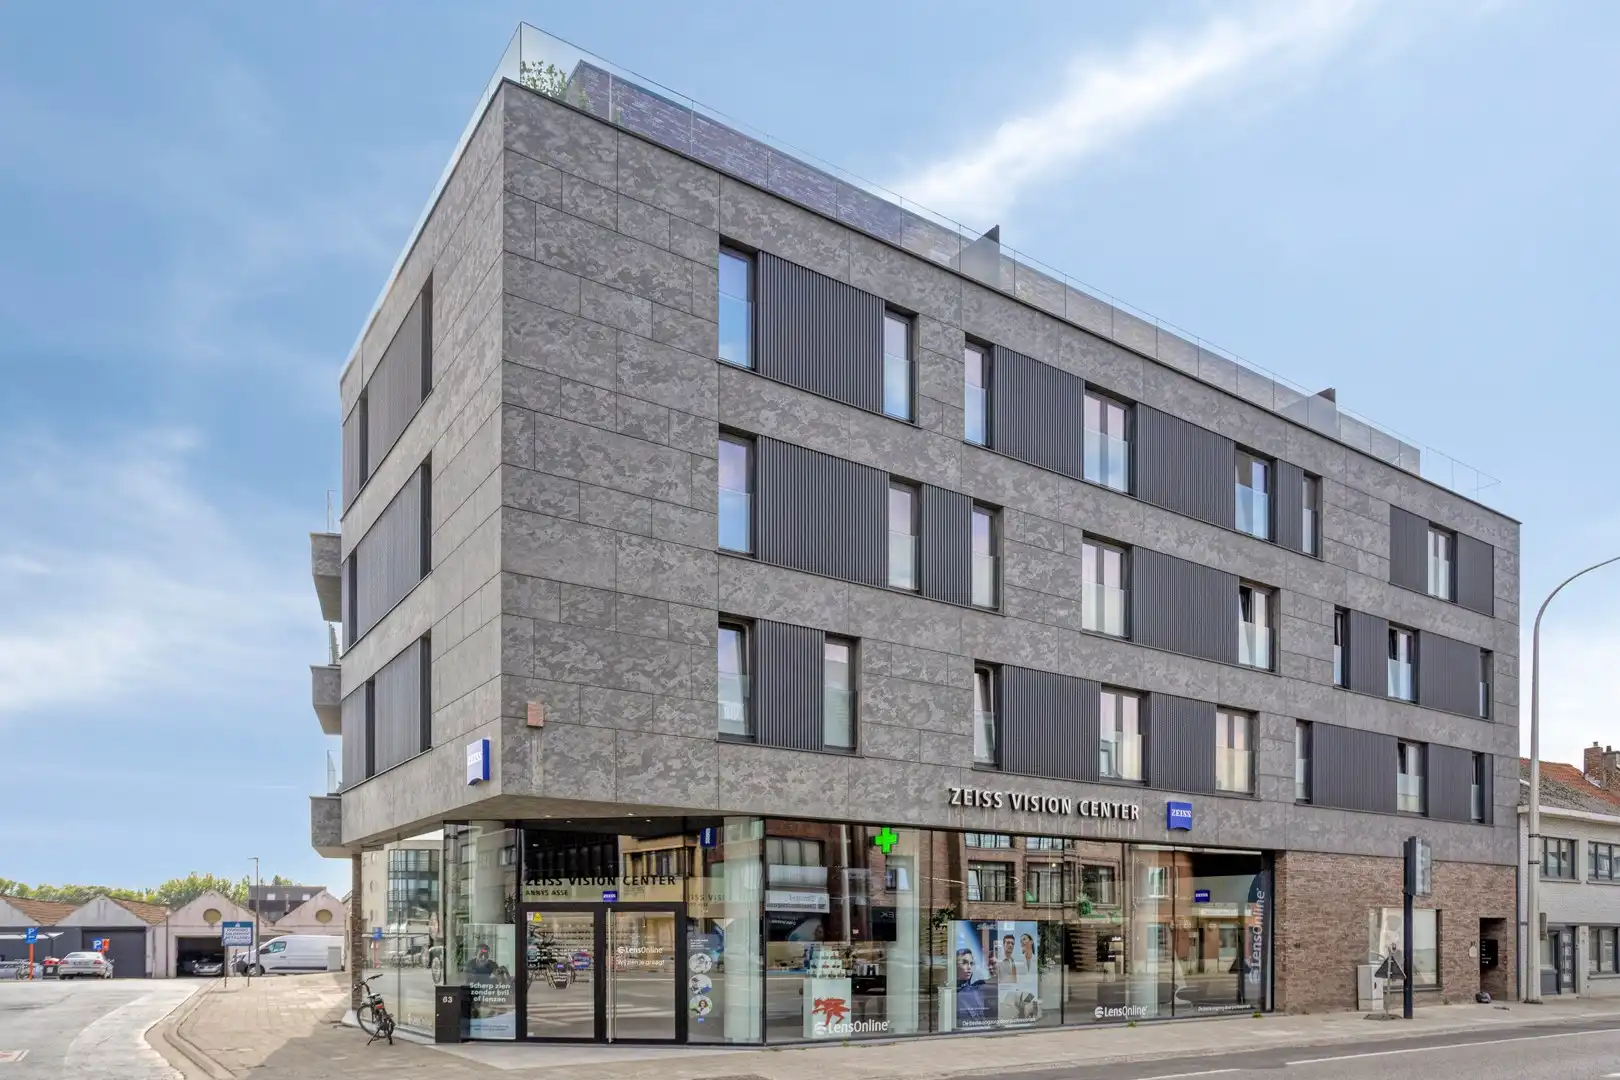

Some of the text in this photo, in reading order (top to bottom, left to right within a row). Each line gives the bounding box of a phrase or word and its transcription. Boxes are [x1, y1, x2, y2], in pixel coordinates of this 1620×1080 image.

[950, 787, 1140, 820] ZEISS VISION CENTER
[1171, 808, 1191, 818] ZEISS
[525, 875, 675, 886] ZEISS VISION CENTER
[1252, 890, 1265, 967] LensOnline
[93, 940, 102, 950] P
[625, 946, 664, 954] LensOnline
[442, 996, 453, 1004] 63
[1104, 1004, 1147, 1017] LensOnline
[828, 1018, 888, 1034] LensOnline
